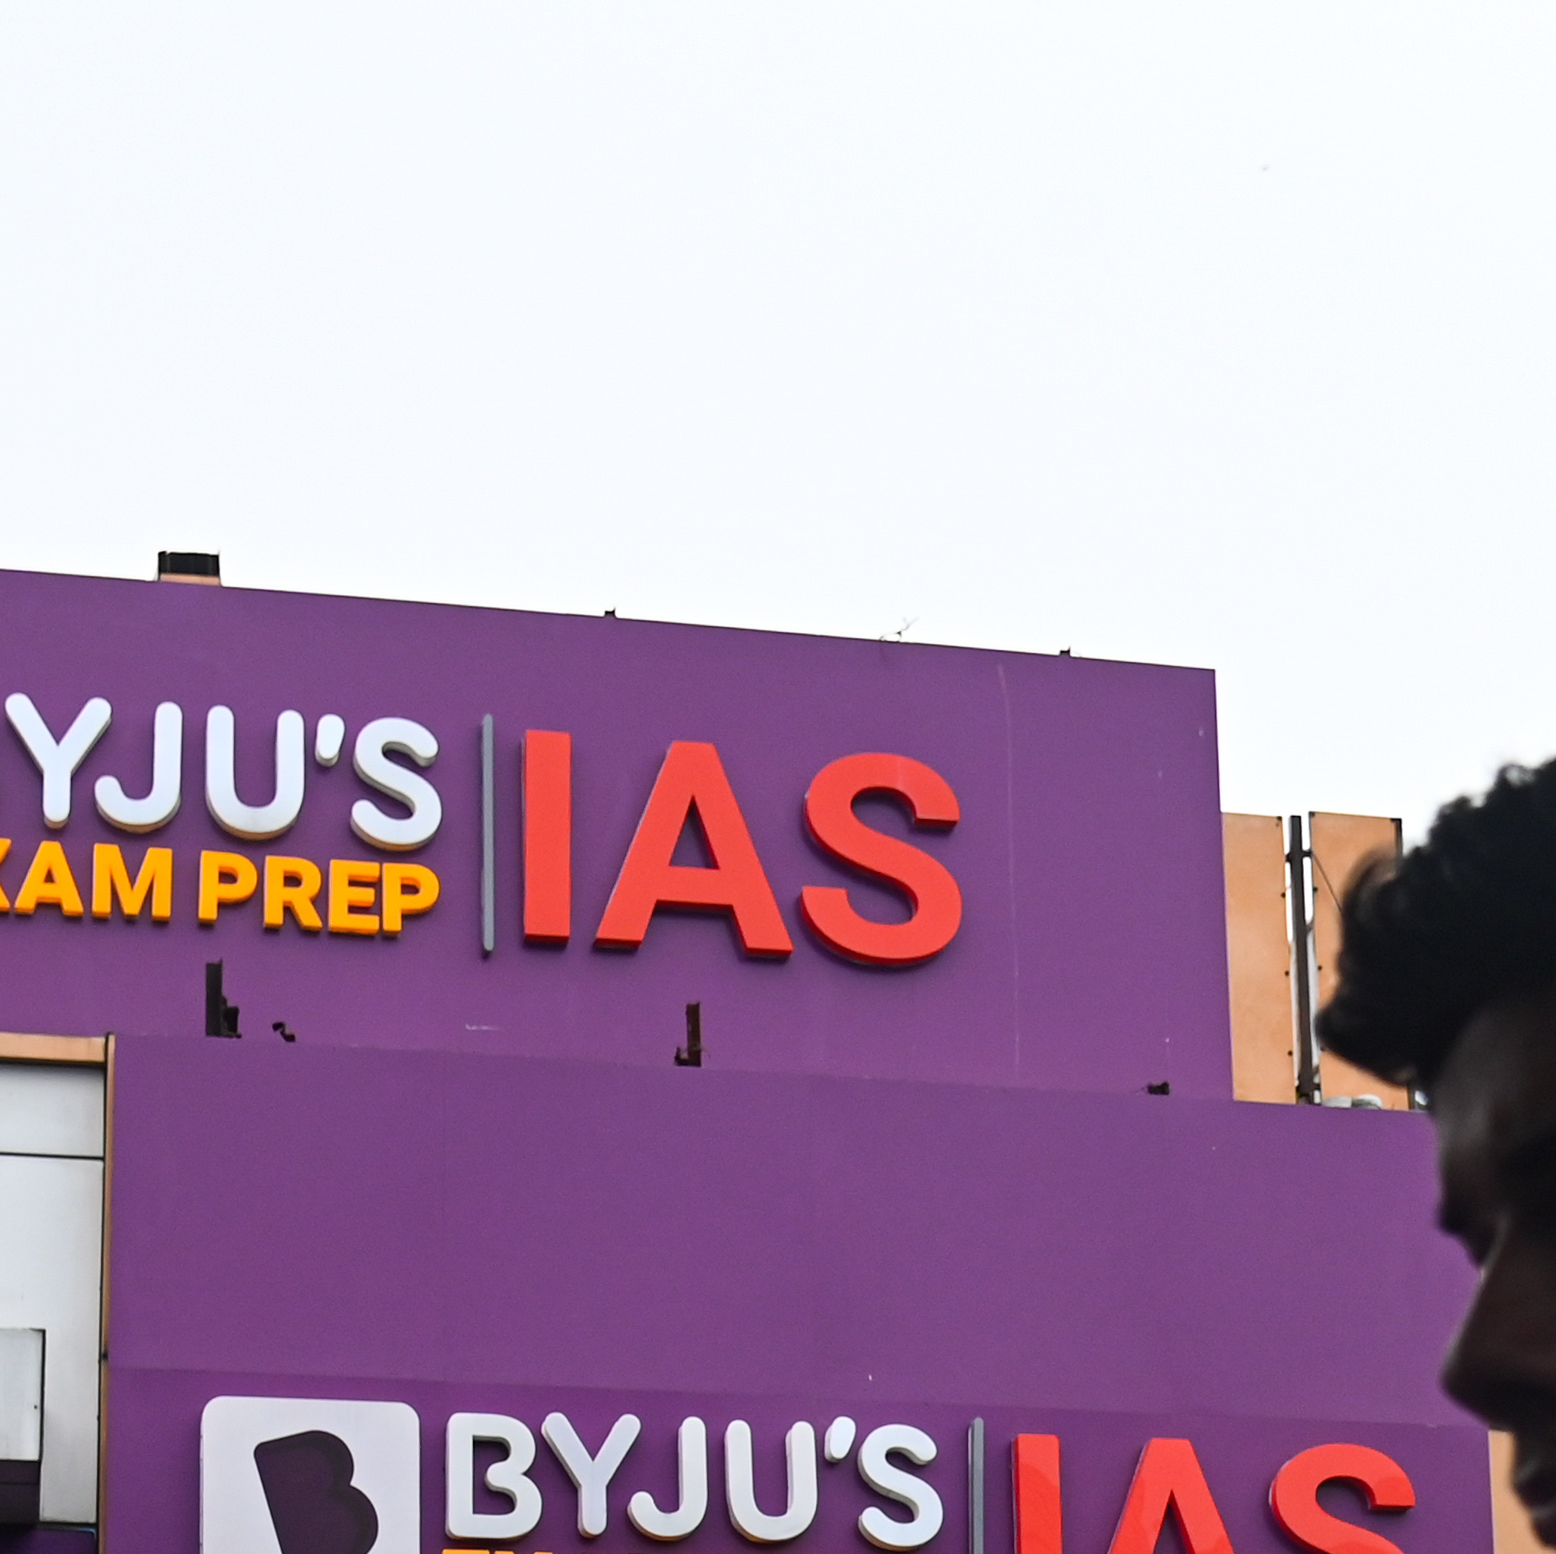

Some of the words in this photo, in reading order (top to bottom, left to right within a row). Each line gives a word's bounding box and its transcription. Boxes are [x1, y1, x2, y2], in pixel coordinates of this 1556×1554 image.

[198, 850, 441, 936] PREP
[522, 729, 962, 966] IAS
[444, 1413, 944, 1551] BYJU'S
